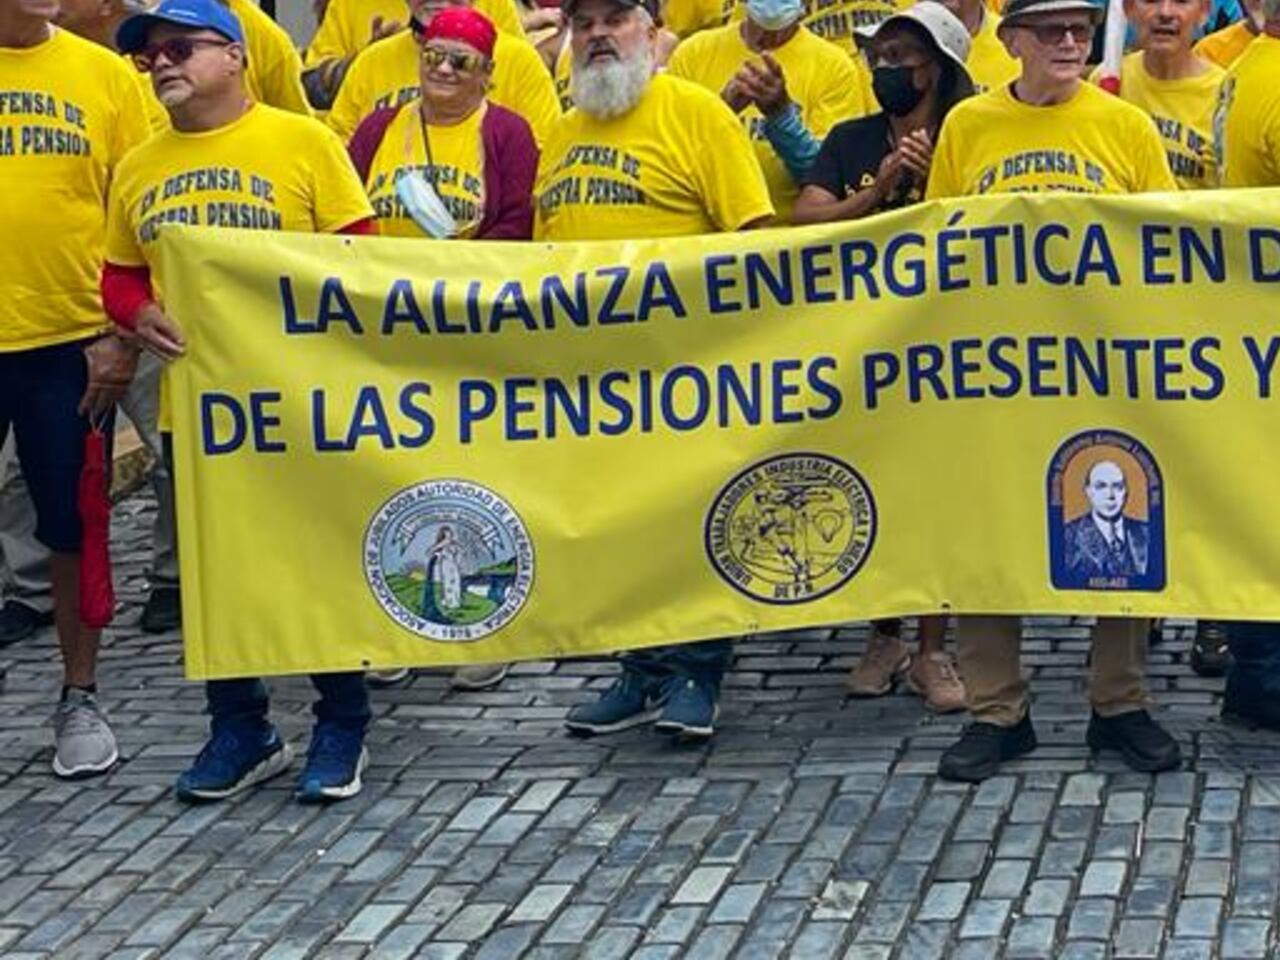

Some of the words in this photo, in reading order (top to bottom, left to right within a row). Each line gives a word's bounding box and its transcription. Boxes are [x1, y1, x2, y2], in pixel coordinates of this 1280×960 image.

[162, 169, 243, 201] DEFENSA
[250, 174, 275, 204] DE
[1002, 150, 1078, 180] DEFENSA
[1084, 159, 1106, 189] DE
[278, 276, 364, 336] LA
[381, 261, 687, 336] ALIANZA
[705, 210, 1122, 315] ENERGÉTICA
[1141, 224, 1227, 284] EN
[200, 391, 287, 455] DE
[311, 381, 436, 452] LAS
[458, 355, 843, 445] PENSIONES
[863, 335, 1226, 410] PRESENTES
